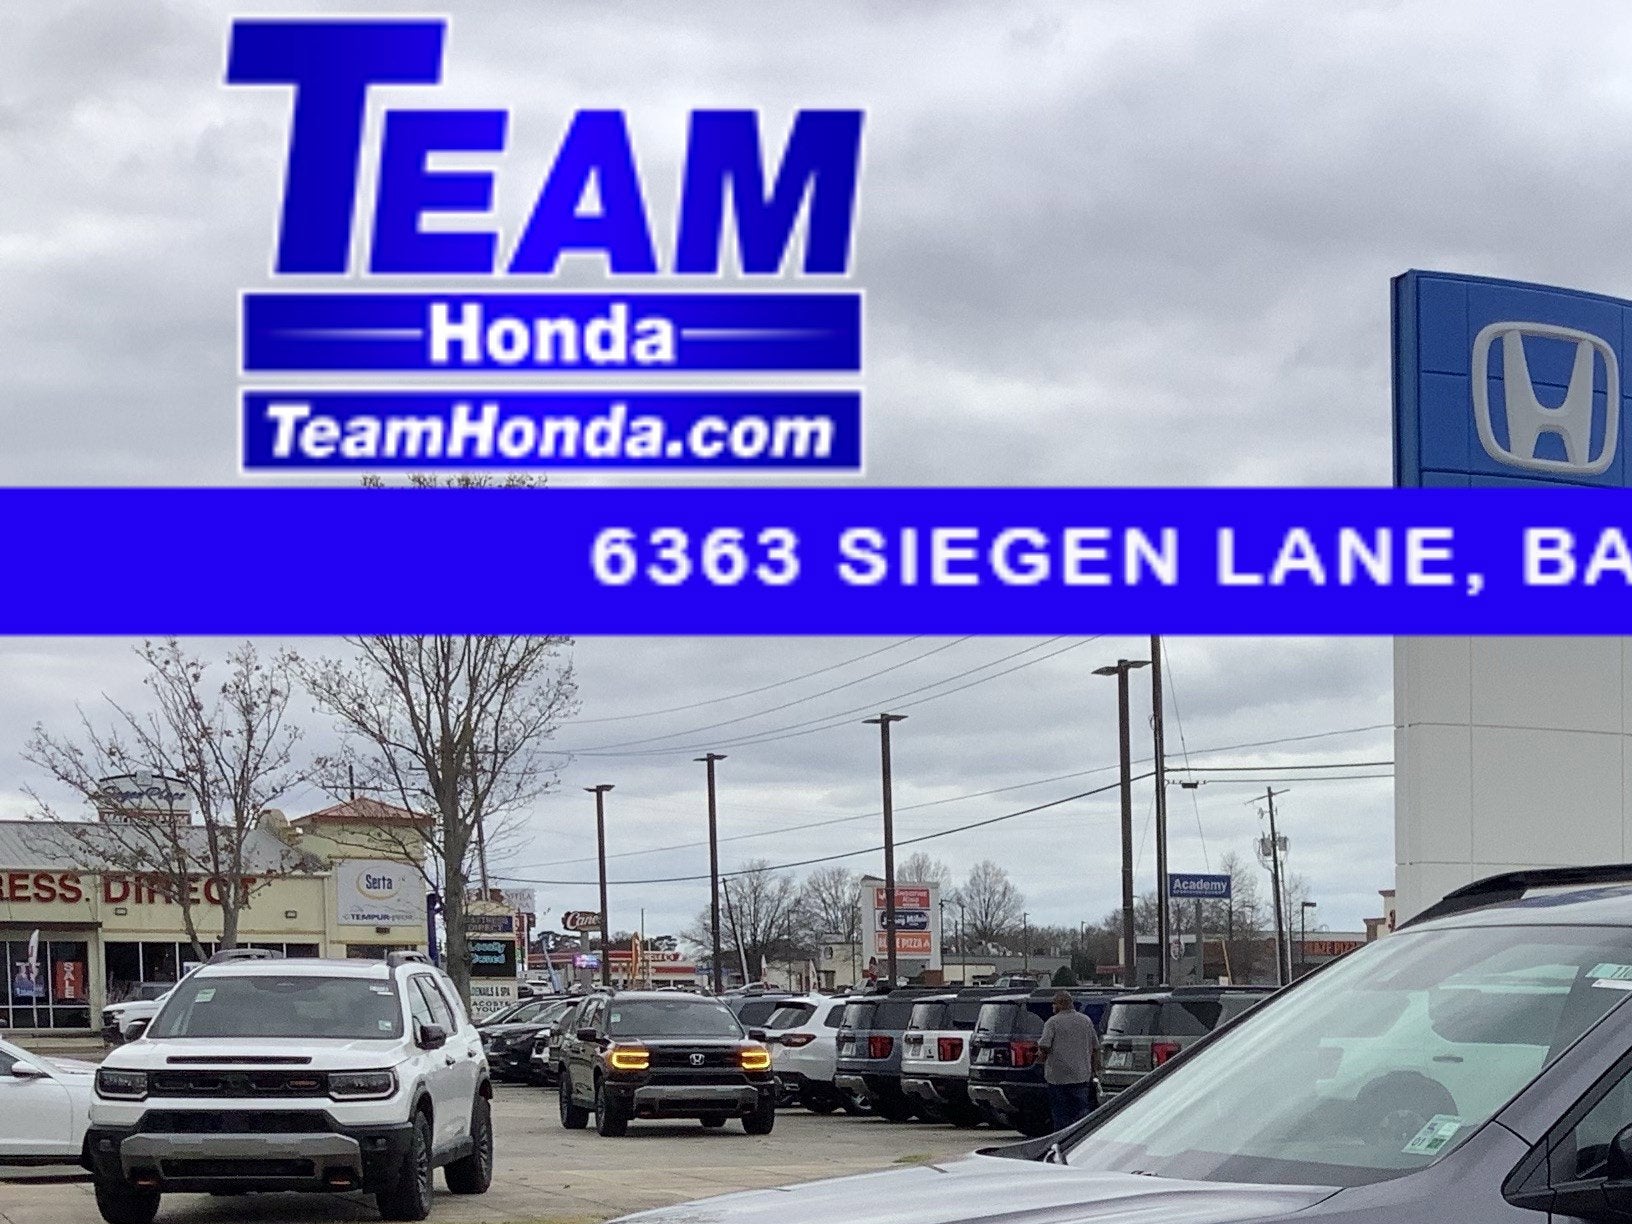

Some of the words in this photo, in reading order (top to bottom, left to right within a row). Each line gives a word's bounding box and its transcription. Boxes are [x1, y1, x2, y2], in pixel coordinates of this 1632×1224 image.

[0, 872, 83, 905] ESS
[365, 873, 394, 890] Serta
[1172, 878, 1228, 893] Academy
[63, 961, 75, 998] SALE
